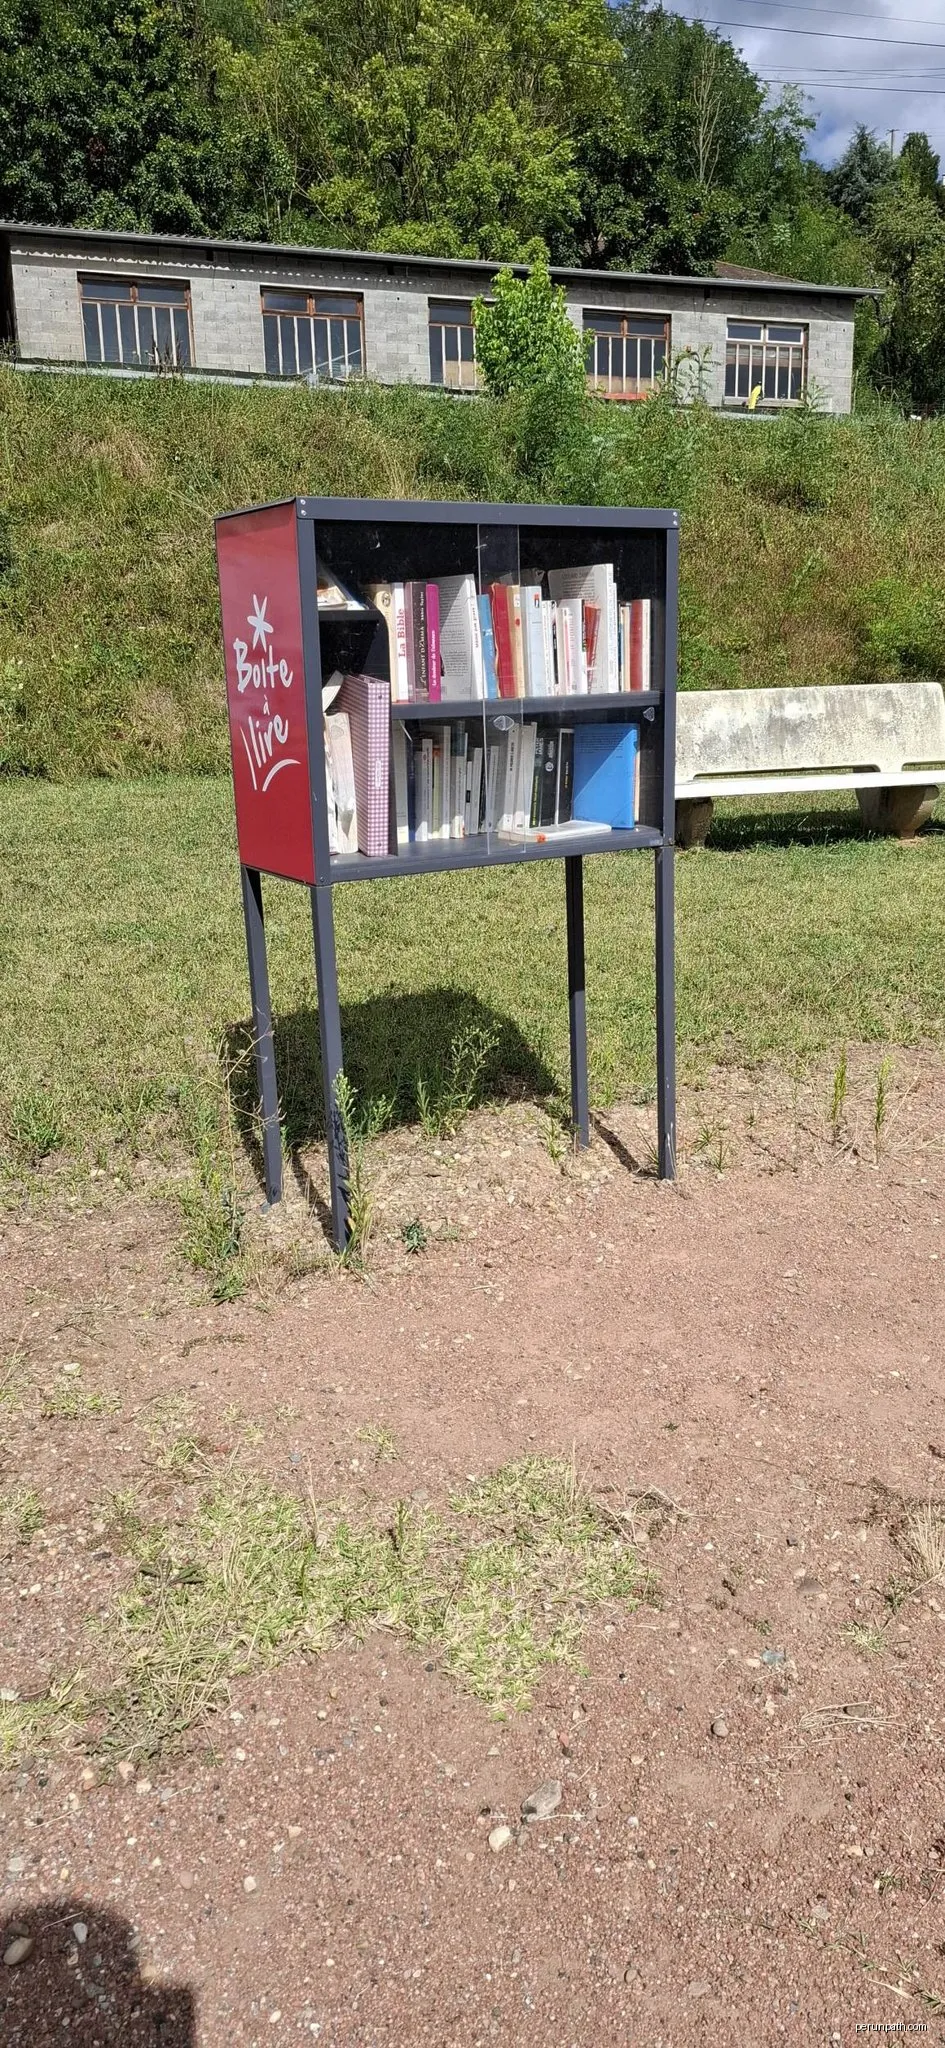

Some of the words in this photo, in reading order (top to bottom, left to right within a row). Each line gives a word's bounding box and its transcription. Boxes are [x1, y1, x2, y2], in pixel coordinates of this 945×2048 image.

[396, 608, 405, 638] Bible
[398, 643, 405, 657] La
[263, 695, 270, 715] à
[248, 714, 289, 769] lire
